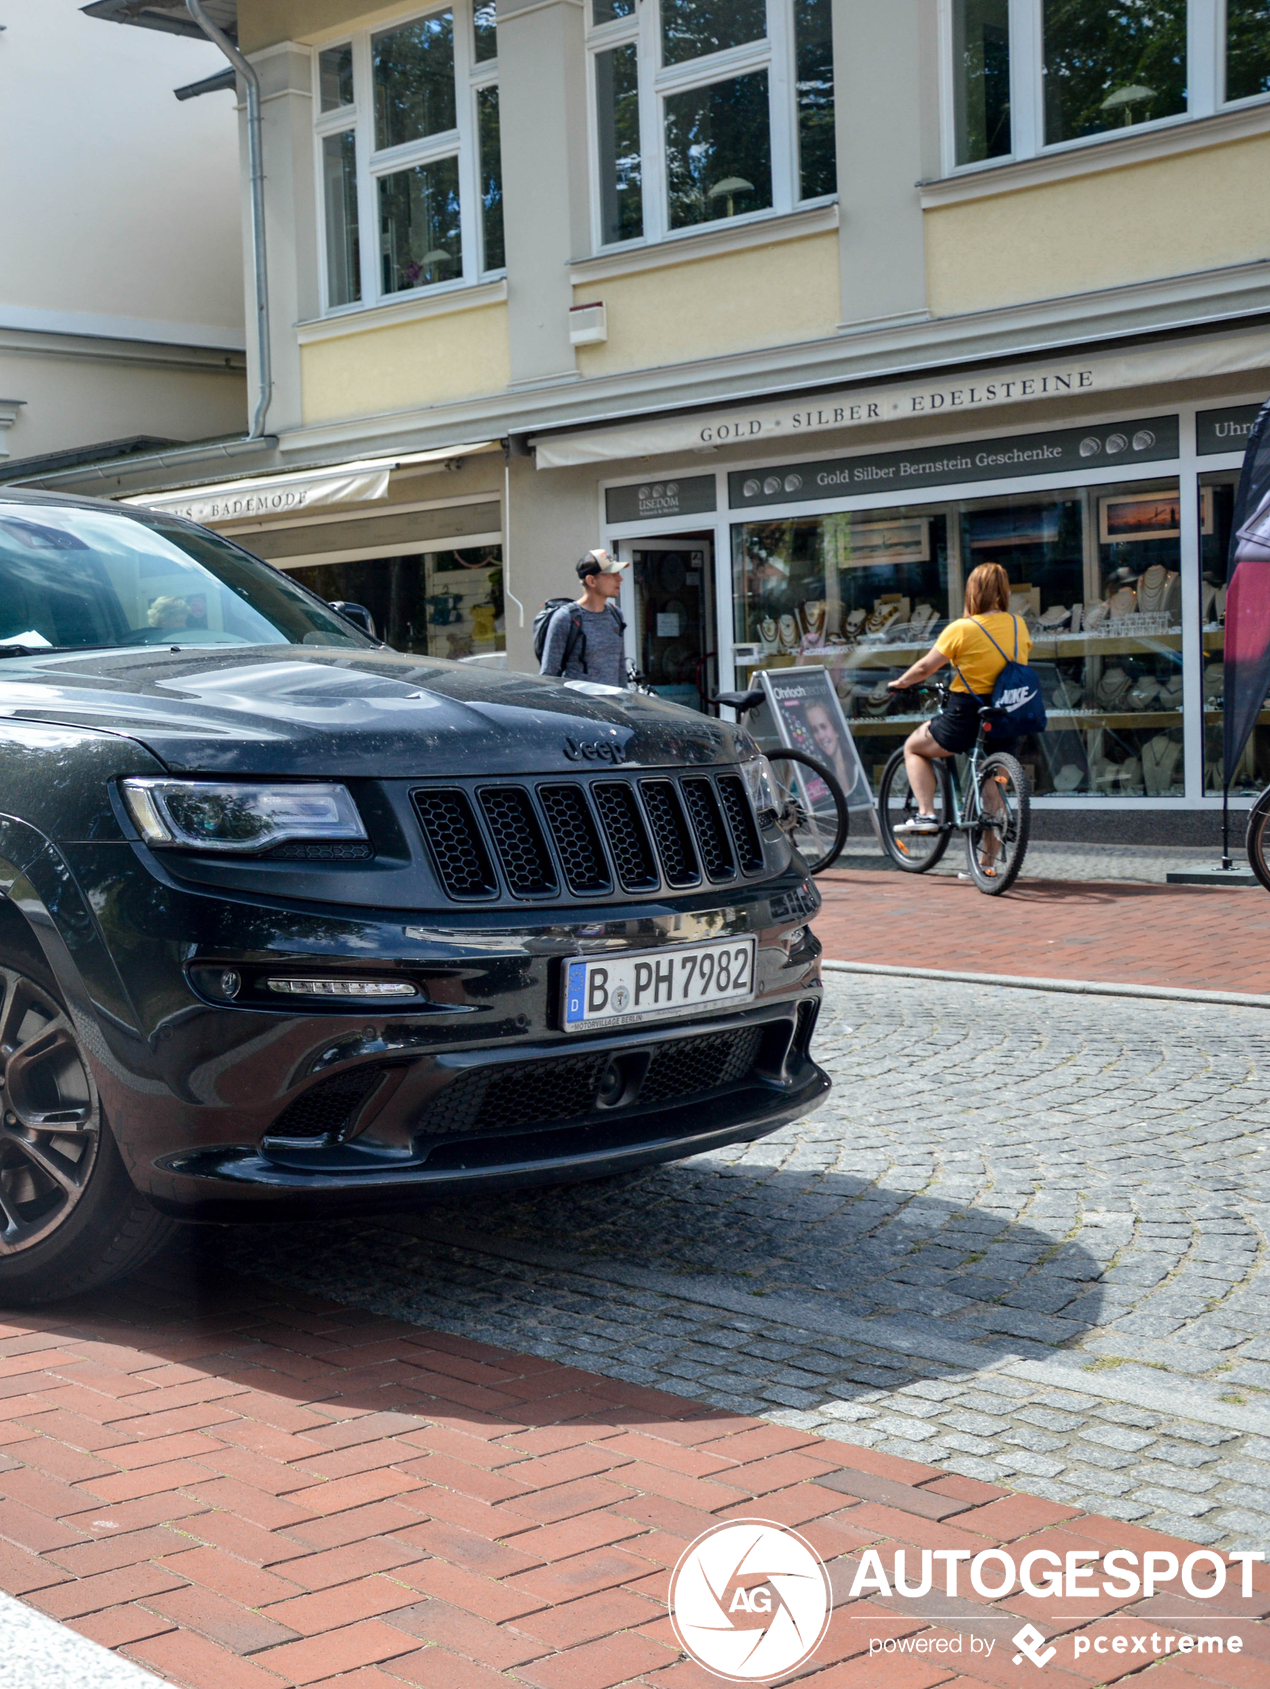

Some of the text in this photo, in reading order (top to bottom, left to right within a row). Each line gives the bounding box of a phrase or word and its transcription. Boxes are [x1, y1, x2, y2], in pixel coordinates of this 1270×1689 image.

[700, 370, 1093, 442] GOLD SILBER EDELSTEINE
[817, 445, 1062, 486] Gold Silber Bernstein Geschenke
[211, 491, 308, 517] BADEMODE
[638, 497, 679, 510] USEDOM
[1000, 686, 1029, 704] NIKE
[563, 737, 626, 765] Jeep
[571, 999, 579, 1012] D
[574, 1014, 643, 1031] MOTORVILLAGE BERLIN
